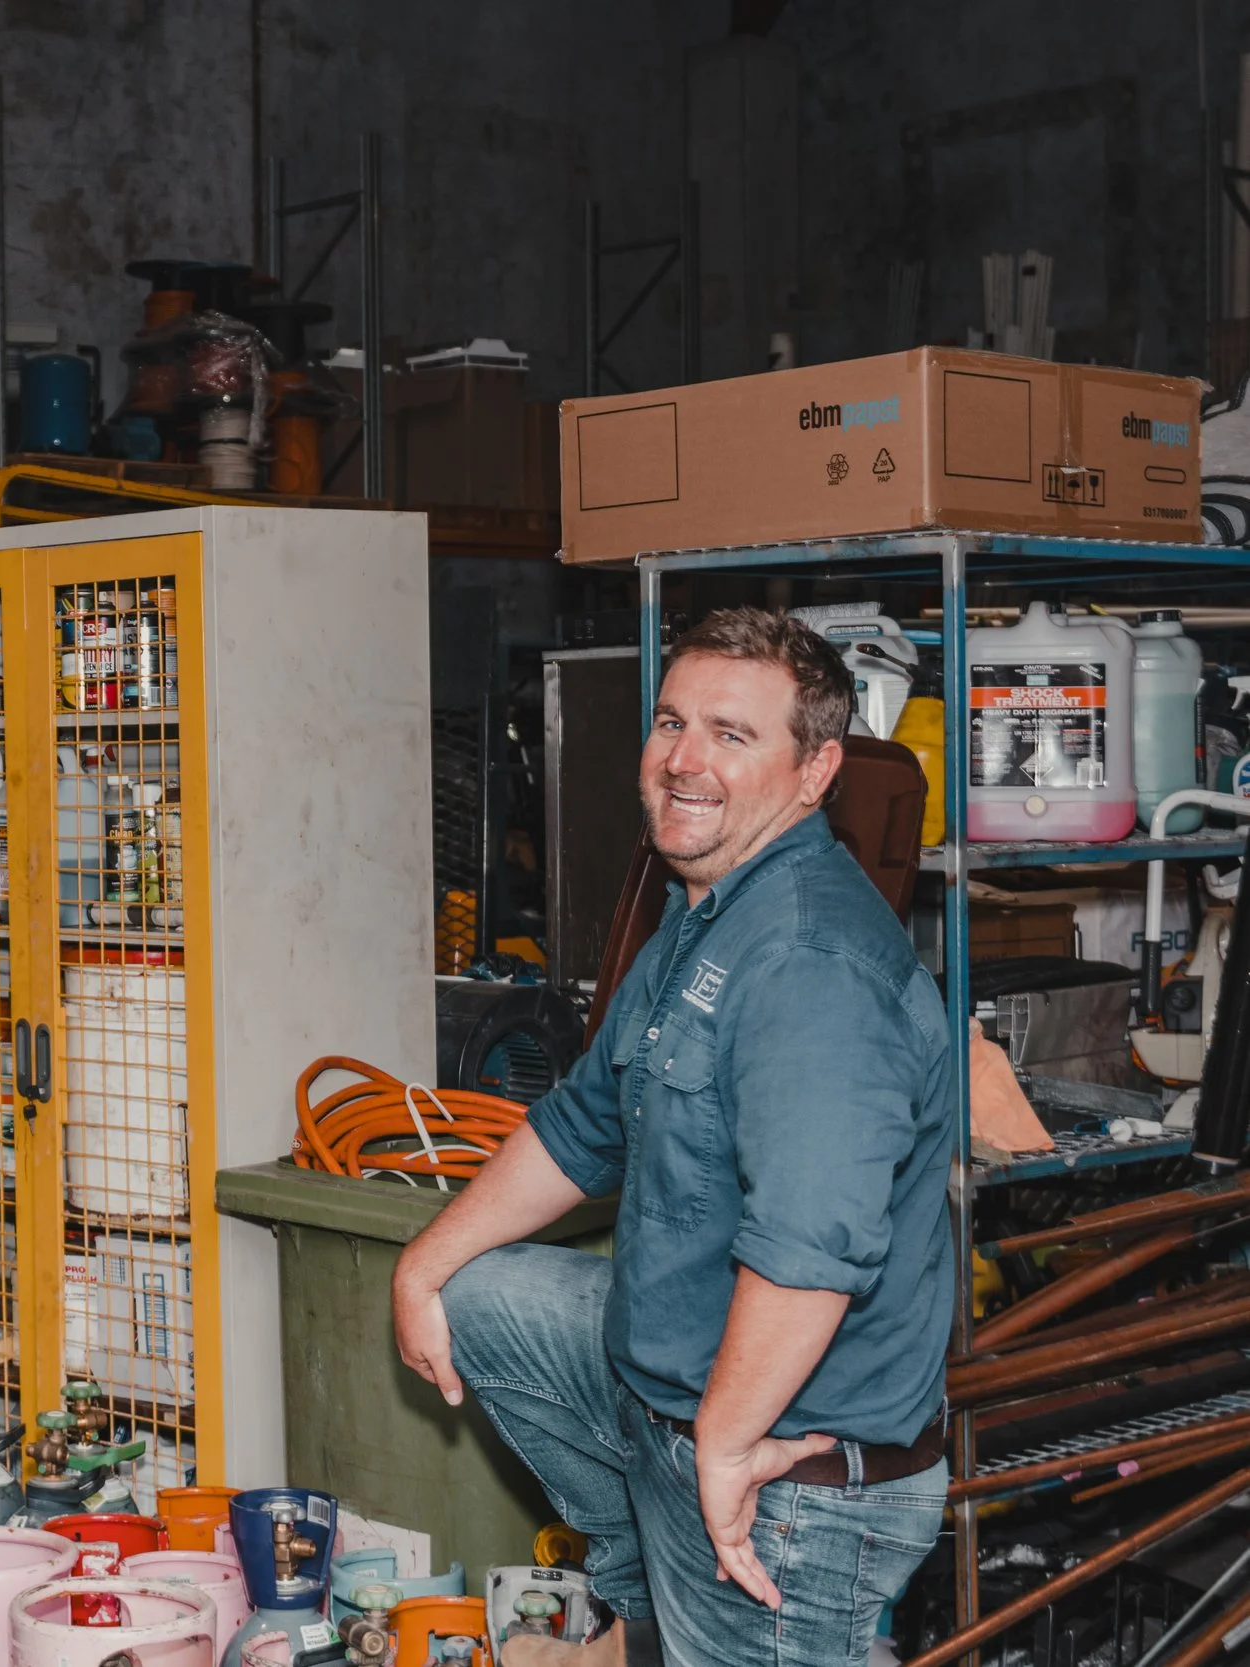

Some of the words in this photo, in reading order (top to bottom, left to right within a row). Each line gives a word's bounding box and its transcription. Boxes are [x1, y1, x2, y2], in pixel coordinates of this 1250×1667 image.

[877, 475, 891, 483] PAP
[1010, 688, 1064, 698] SHOCK
[994, 697, 1081, 707] TREATMENT
